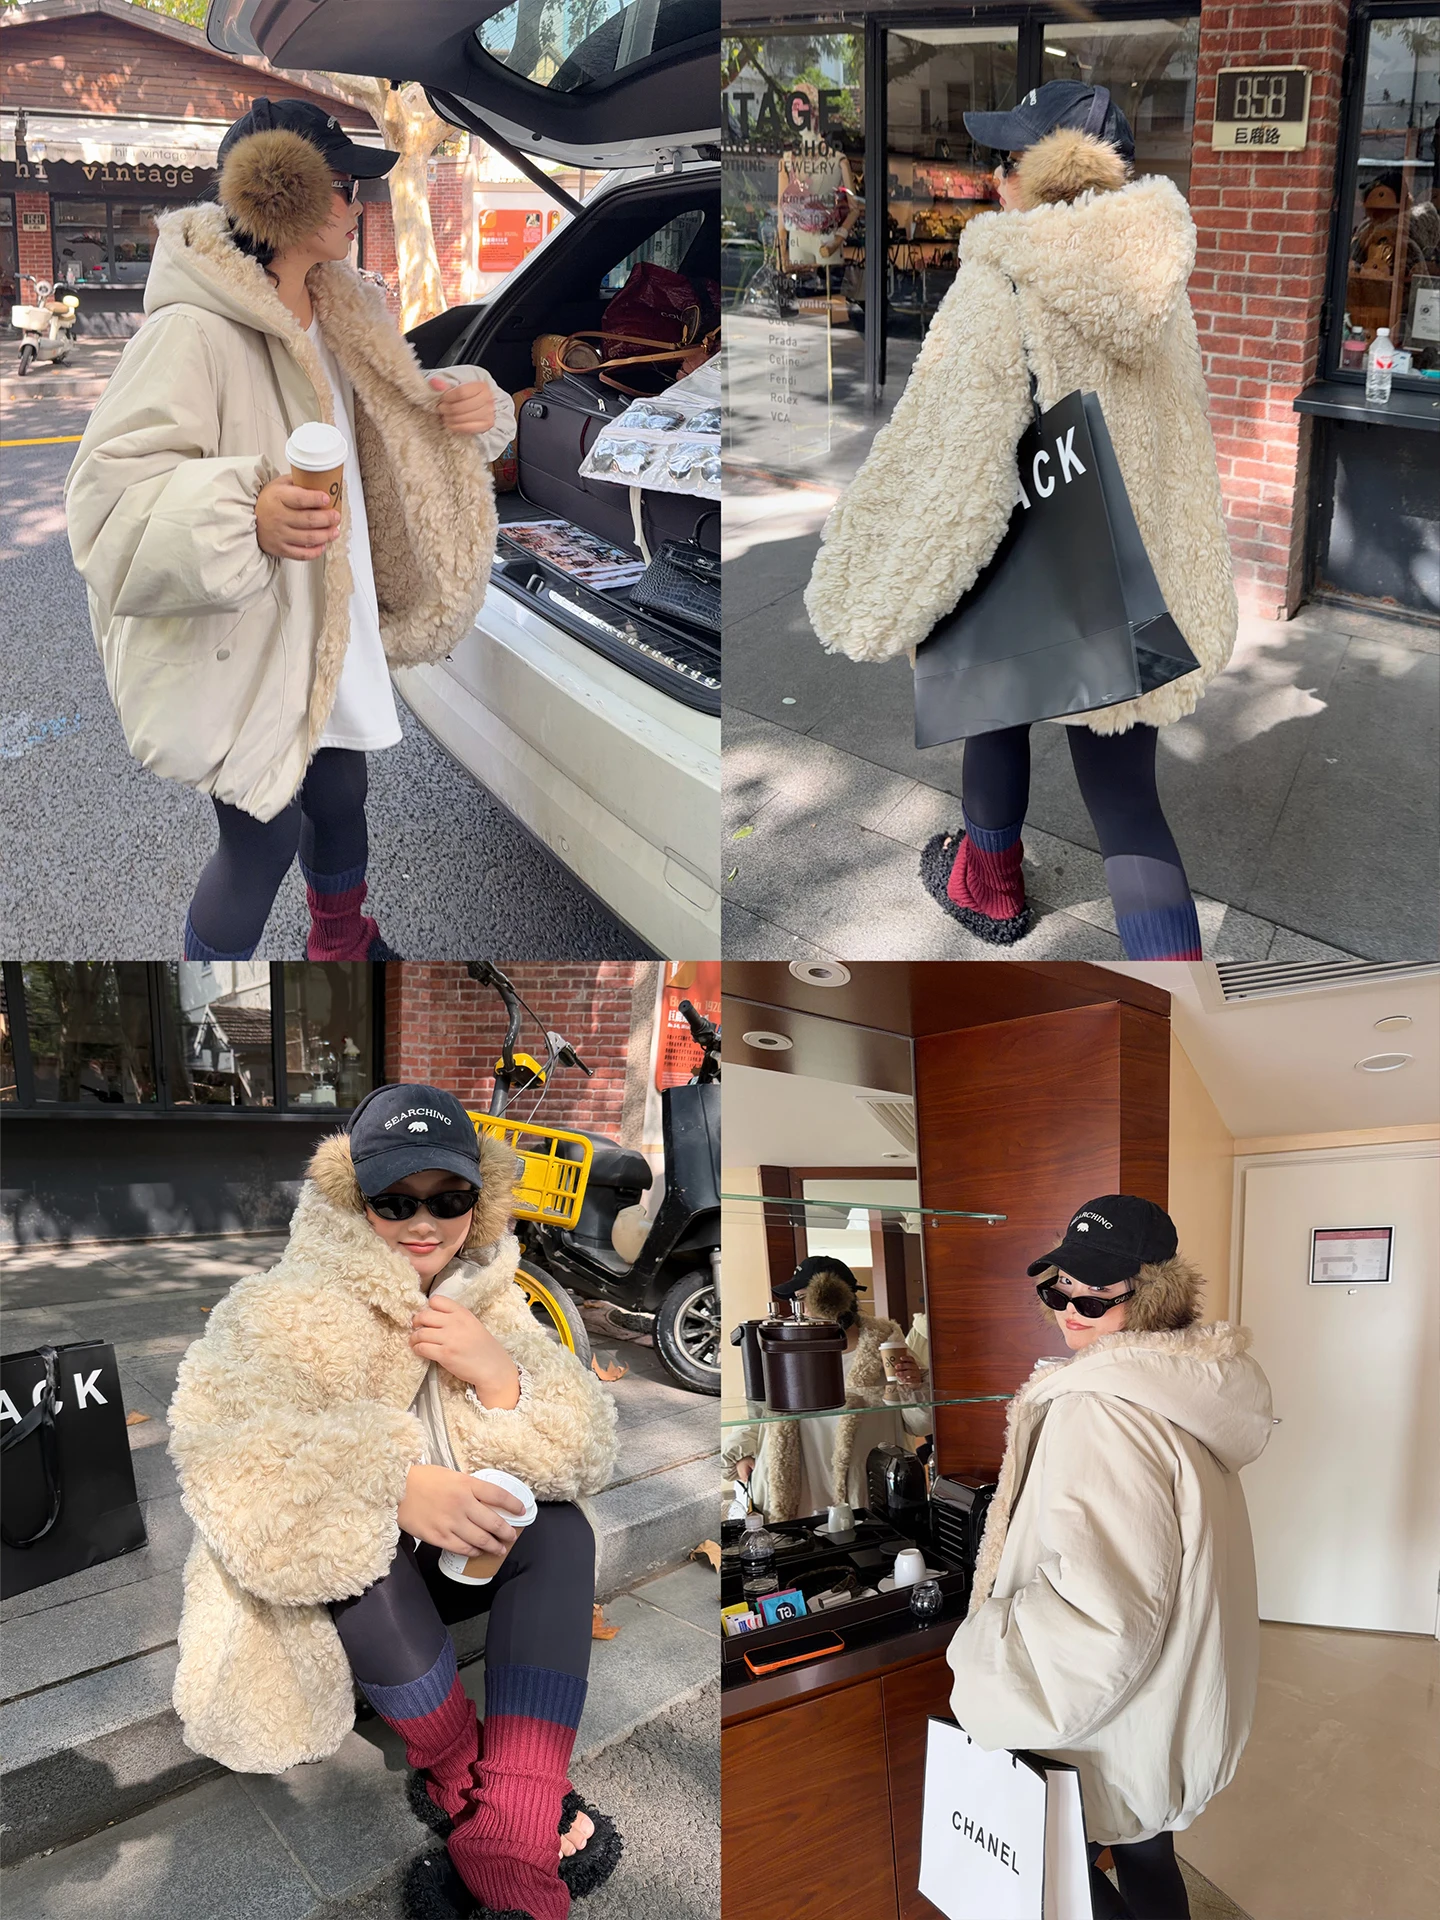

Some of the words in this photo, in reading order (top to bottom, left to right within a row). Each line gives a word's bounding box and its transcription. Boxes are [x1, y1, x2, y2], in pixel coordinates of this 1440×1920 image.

[1234, 76, 1287, 118] 858
[15, 159, 48, 179] hi
[82, 164, 194, 188] vintage
[776, 161, 836, 175] JEWELRY
[768, 334, 797, 347] Prada
[769, 353, 800, 367] Celine
[770, 373, 797, 386] Fendi
[770, 393, 798, 406] Rolex
[770, 411, 791, 424] VCA
[384, 1108, 452, 1131] SEARCHING
[952, 1810, 1020, 1876] CHANEL
